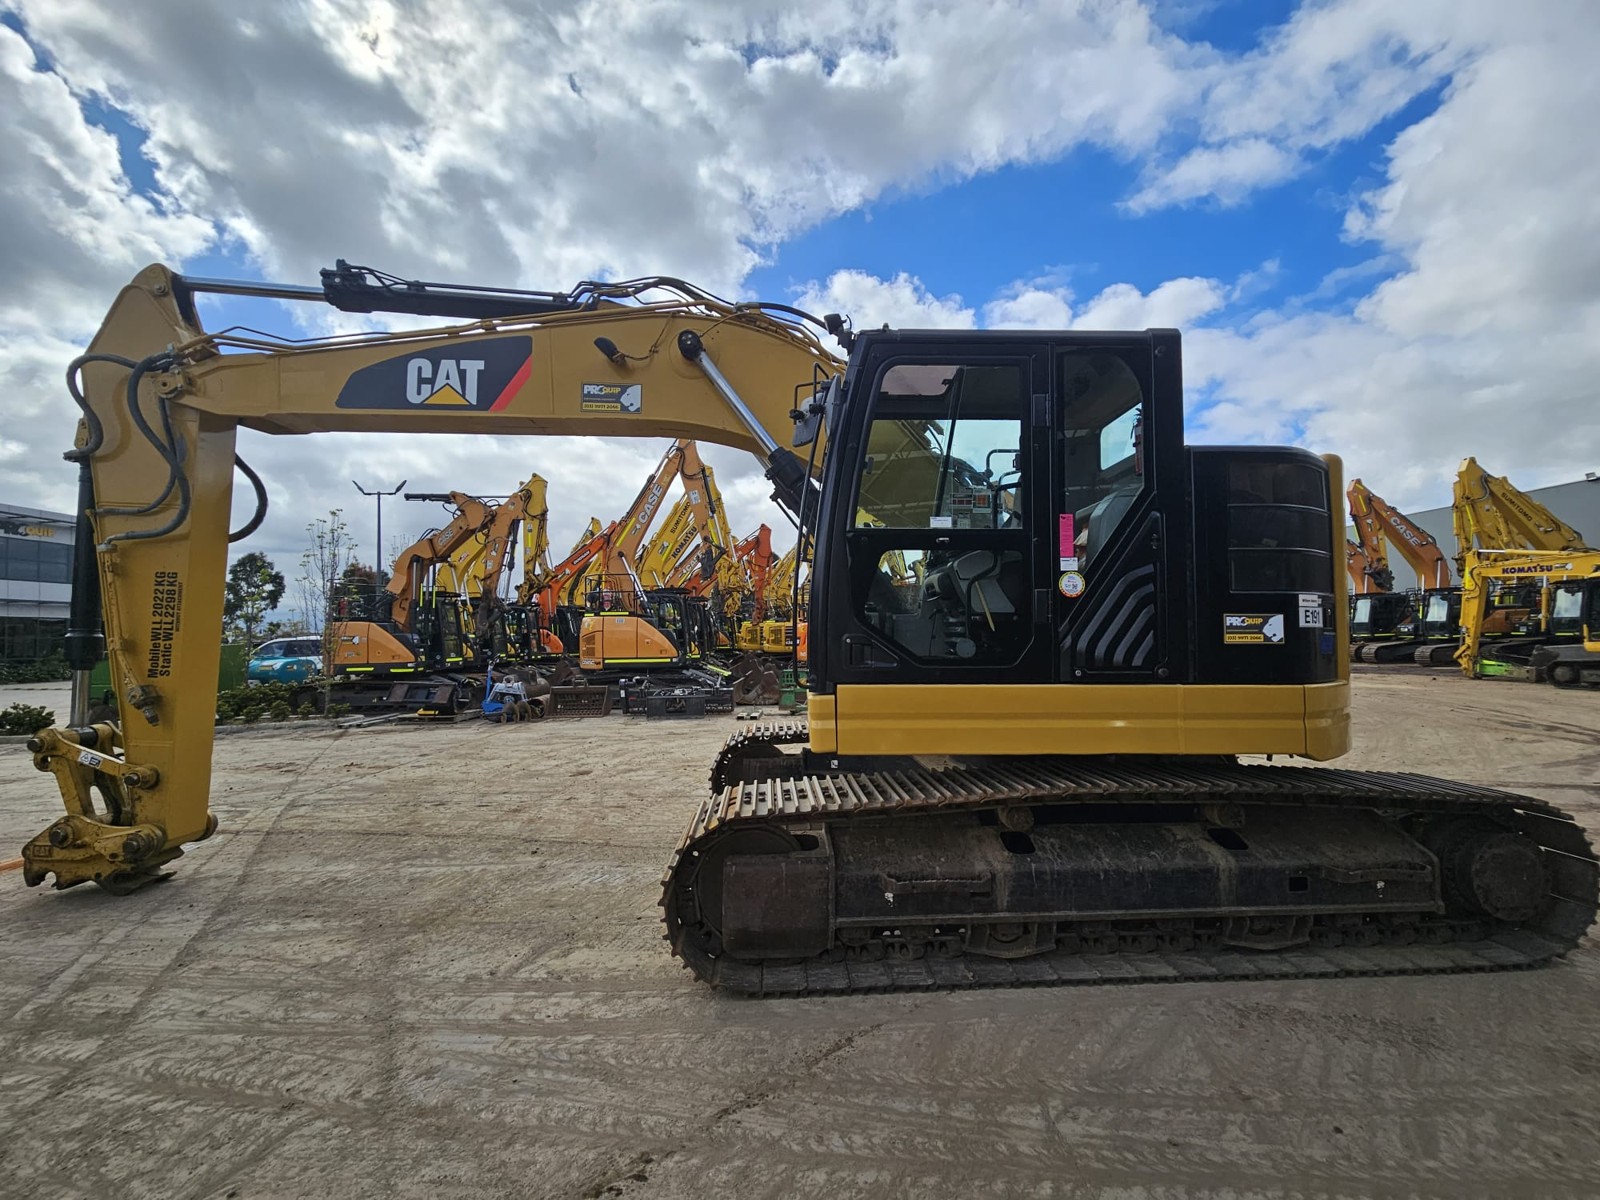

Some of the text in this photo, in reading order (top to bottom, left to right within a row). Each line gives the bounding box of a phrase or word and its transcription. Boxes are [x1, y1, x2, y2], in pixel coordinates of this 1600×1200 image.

[406, 358, 485, 405] CAT
[584, 385, 621, 394] PROQUIP
[638, 483, 663, 524] CASE
[1501, 492, 1533, 522] SUMITOMO
[671, 526, 699, 559] KOMATSU
[1389, 516, 1421, 547] CASE
[1502, 564, 1553, 575] KOMATSU
[147, 571, 166, 678] Mobile WLL 2022 KG
[159, 571, 178, 677] Static WLL 2298 KG
[1226, 616, 1263, 626] PROQUIP
[1304, 610, 1320, 624] E191
